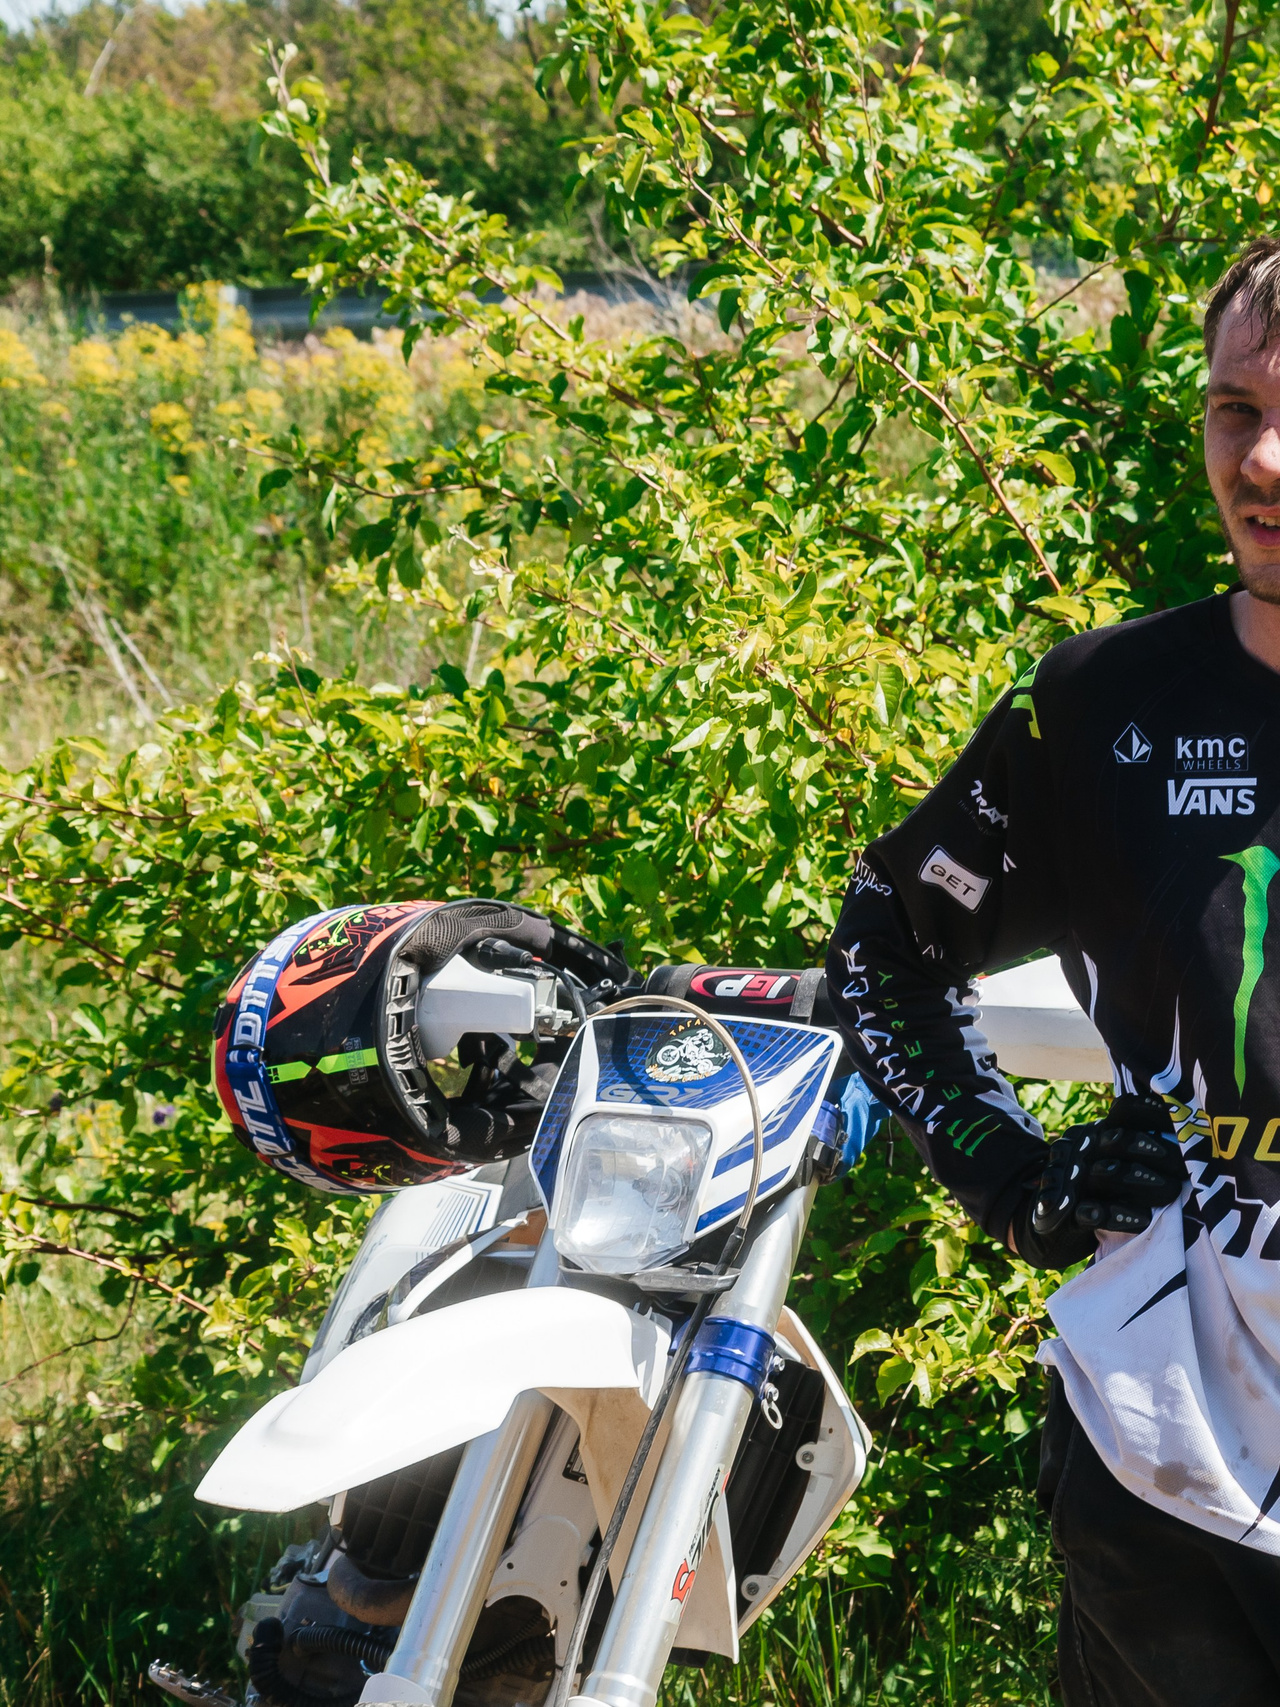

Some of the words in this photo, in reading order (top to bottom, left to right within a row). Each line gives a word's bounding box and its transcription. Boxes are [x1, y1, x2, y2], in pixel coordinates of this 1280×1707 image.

[1176, 736, 1246, 760] kmc
[1182, 759, 1242, 771] WHEELS
[1166, 777, 1258, 816] VANS
[929, 863, 977, 897] GET
